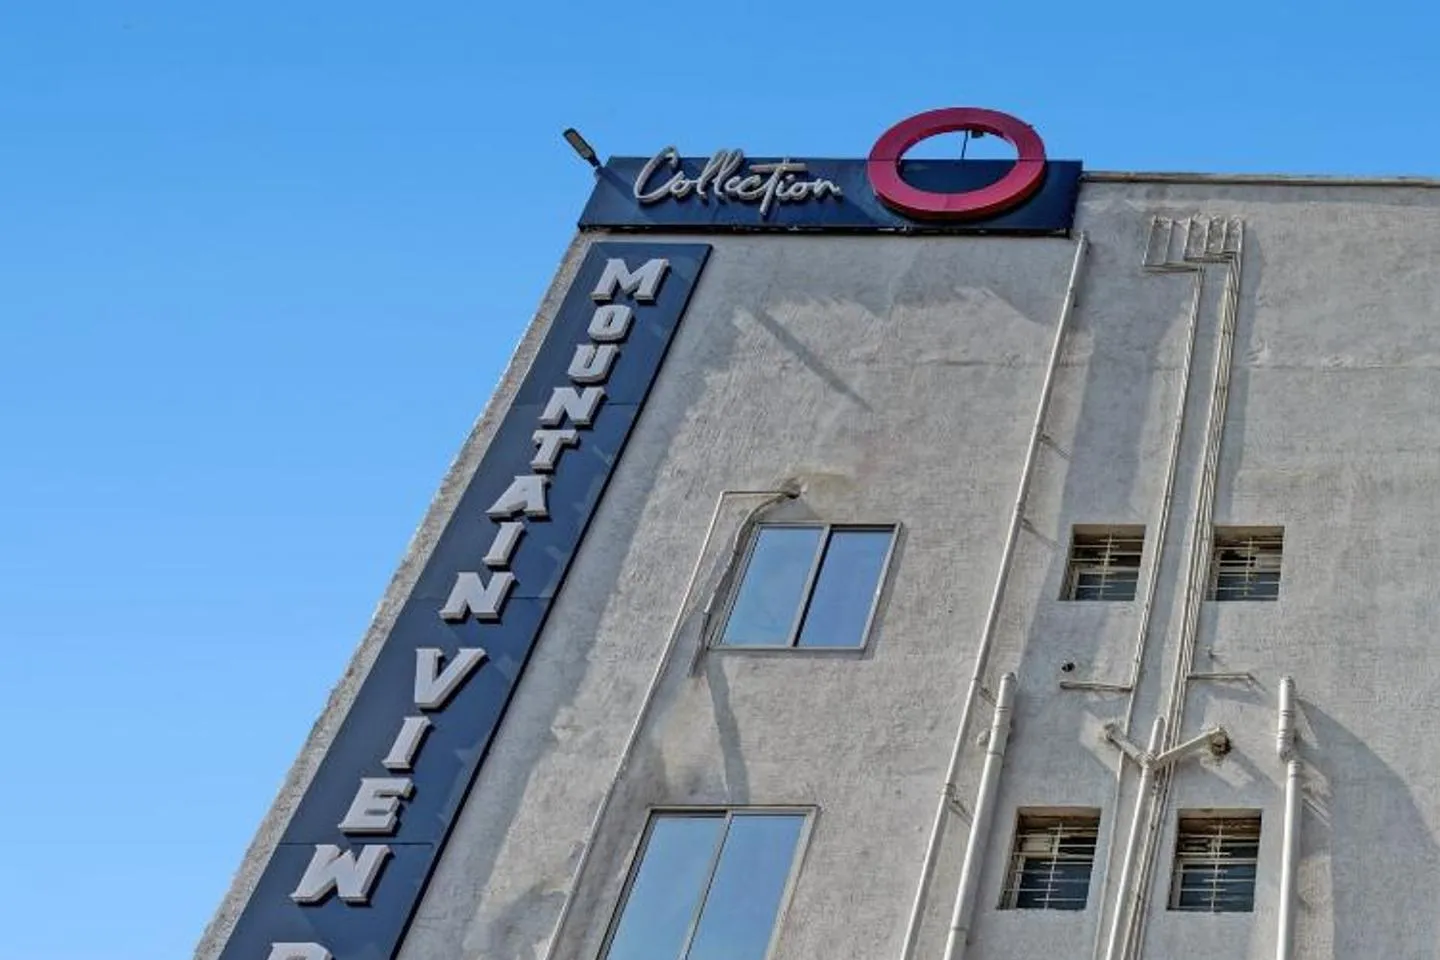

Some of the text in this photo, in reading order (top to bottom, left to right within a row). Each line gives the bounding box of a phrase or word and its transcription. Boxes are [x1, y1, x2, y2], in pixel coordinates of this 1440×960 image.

[633, 146, 841, 220] Collection
[439, 257, 670, 621] MOUNTAIN
[290, 646, 488, 905] VIEW
